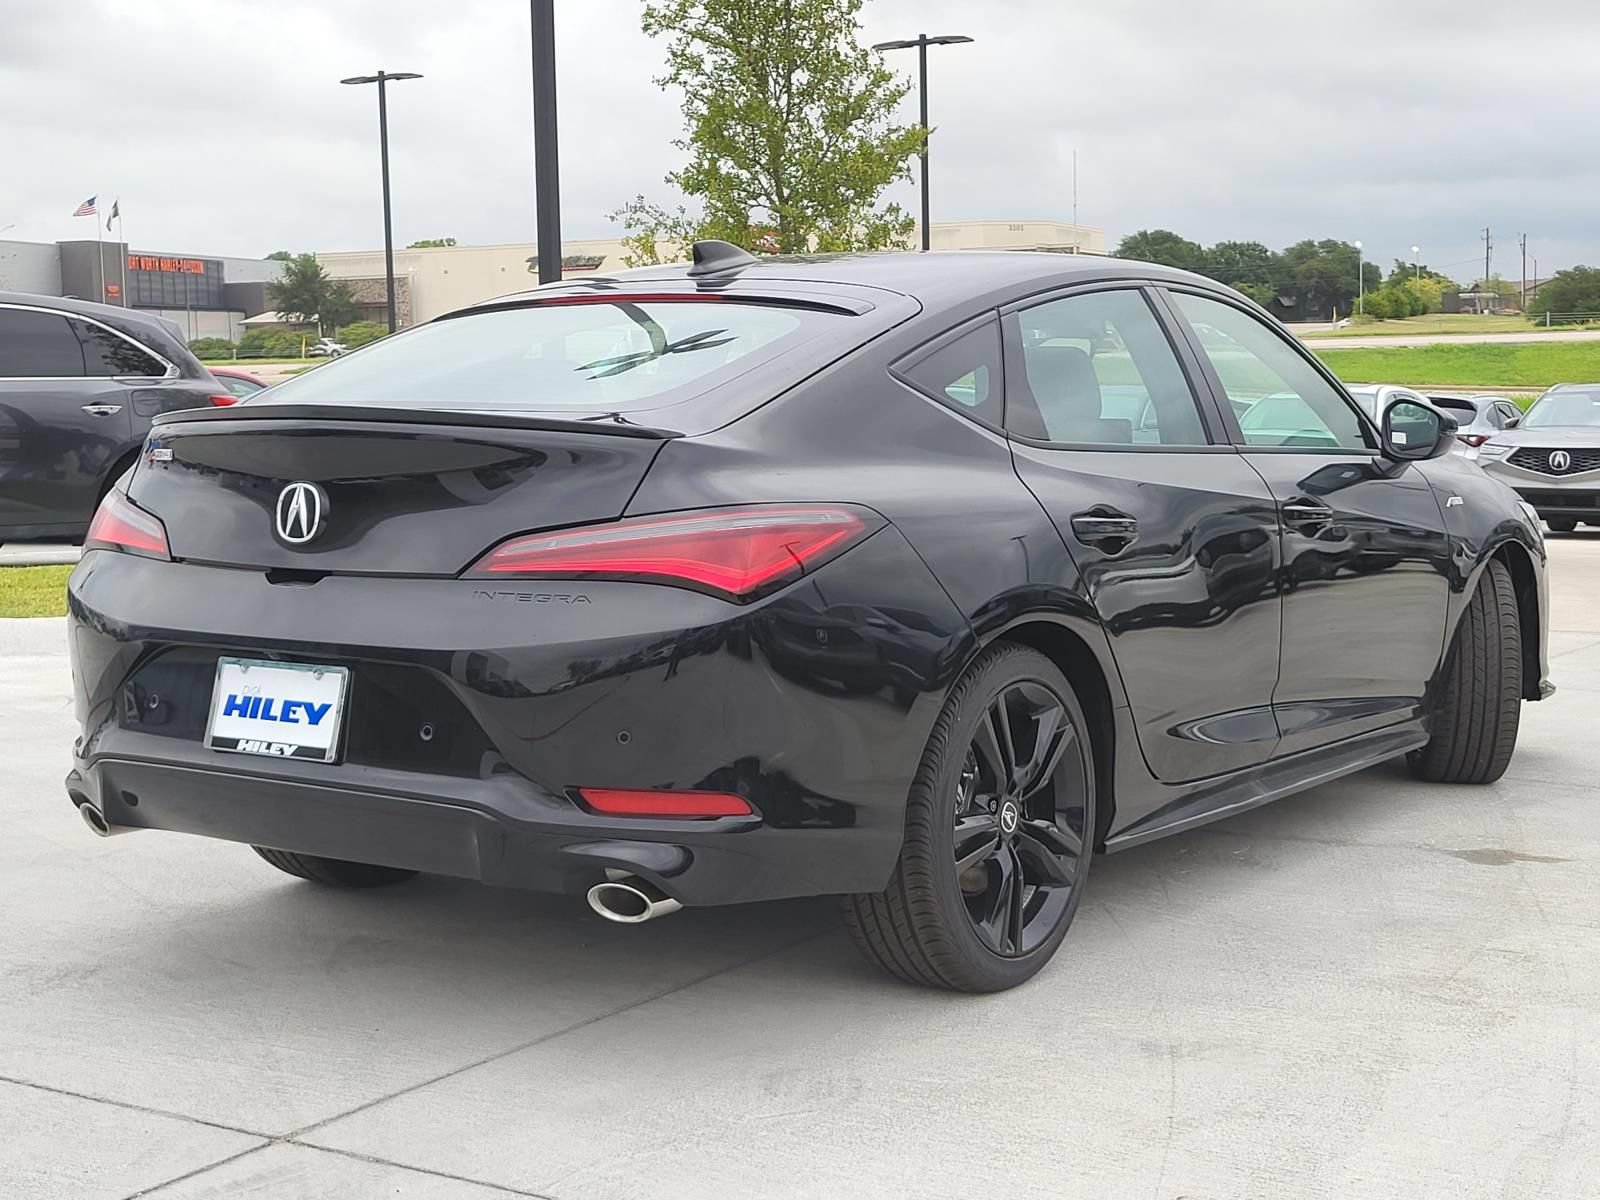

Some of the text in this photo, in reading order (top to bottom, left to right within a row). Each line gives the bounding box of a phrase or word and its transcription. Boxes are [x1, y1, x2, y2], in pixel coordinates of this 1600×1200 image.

[473, 590, 592, 604] INTEGRA
[223, 694, 333, 725] HILEY
[236, 739, 299, 756] HILEY
